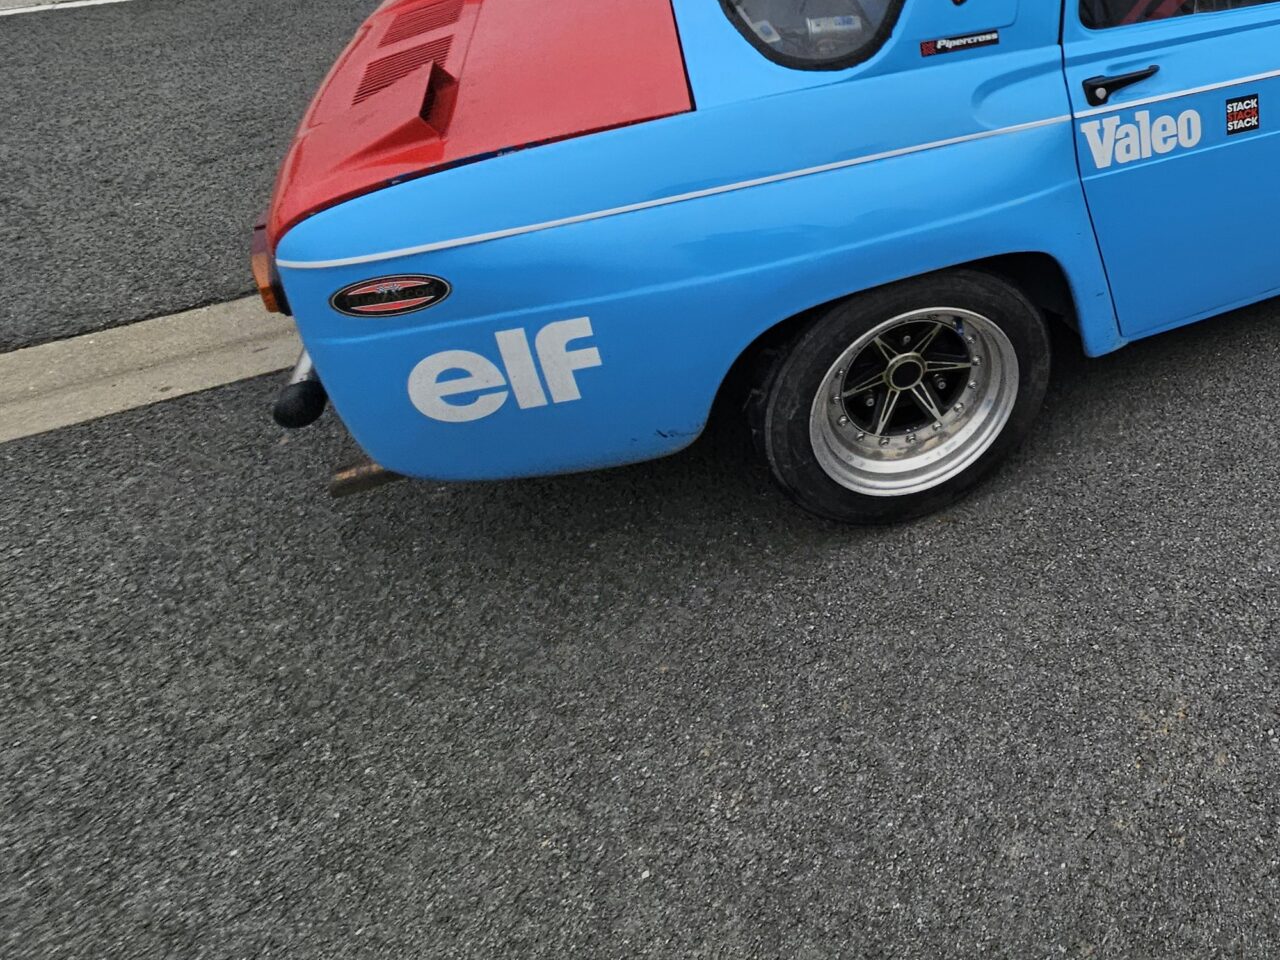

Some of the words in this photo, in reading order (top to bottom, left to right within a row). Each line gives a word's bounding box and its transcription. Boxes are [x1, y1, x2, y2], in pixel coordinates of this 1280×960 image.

[937, 33, 998, 49] Pipercross
[1226, 98, 1258, 113] STACK
[1226, 109, 1258, 122] STACK
[1227, 116, 1258, 131] STACK
[1080, 109, 1202, 169] Valeo
[407, 316, 602, 422] elf
